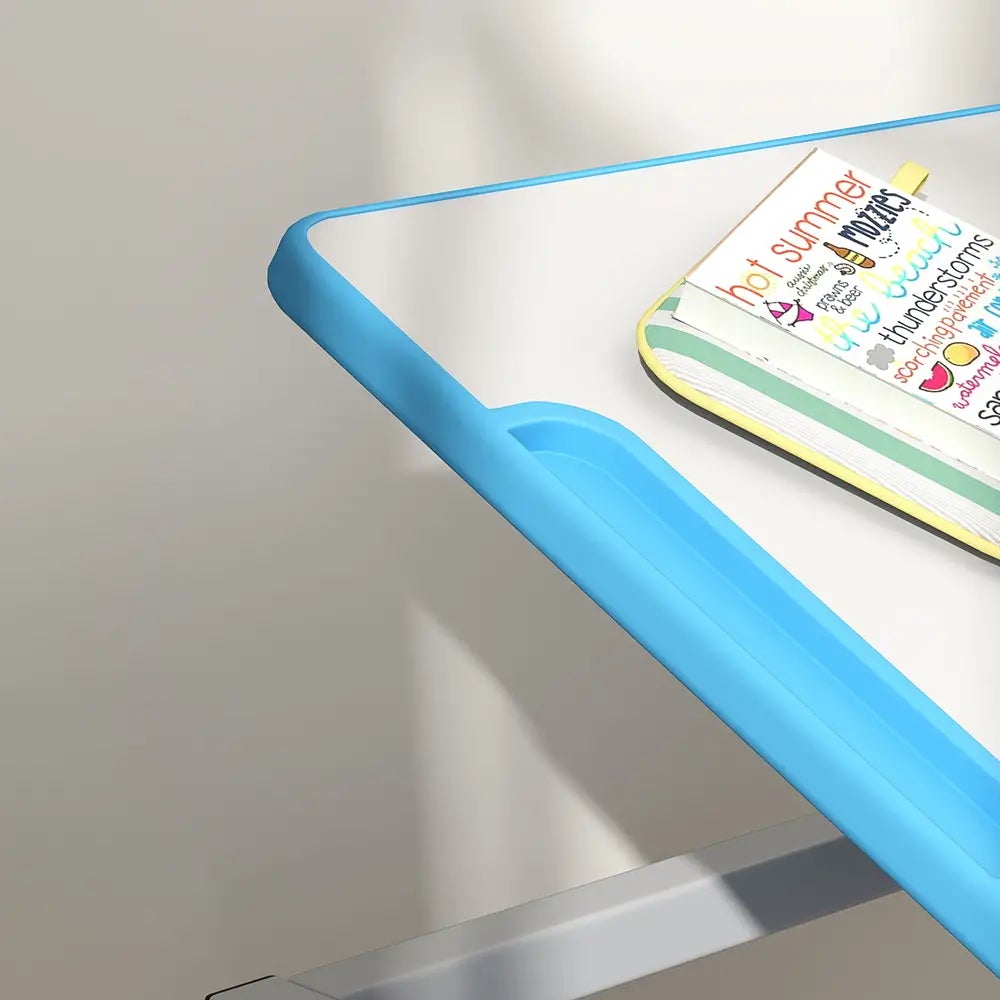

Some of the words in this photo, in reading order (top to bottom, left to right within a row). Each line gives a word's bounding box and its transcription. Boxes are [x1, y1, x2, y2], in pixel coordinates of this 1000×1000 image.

[715, 258, 783, 307] hot
[771, 169, 871, 264] summer
[811, 302, 881, 353] the
[856, 217, 962, 299] beach
[815, 279, 850, 312] prawns
[838, 285, 864, 307] beer
[878, 234, 994, 346] thunderstorms
[830, 304, 847, 315] &
[967, 317, 998, 339] air
